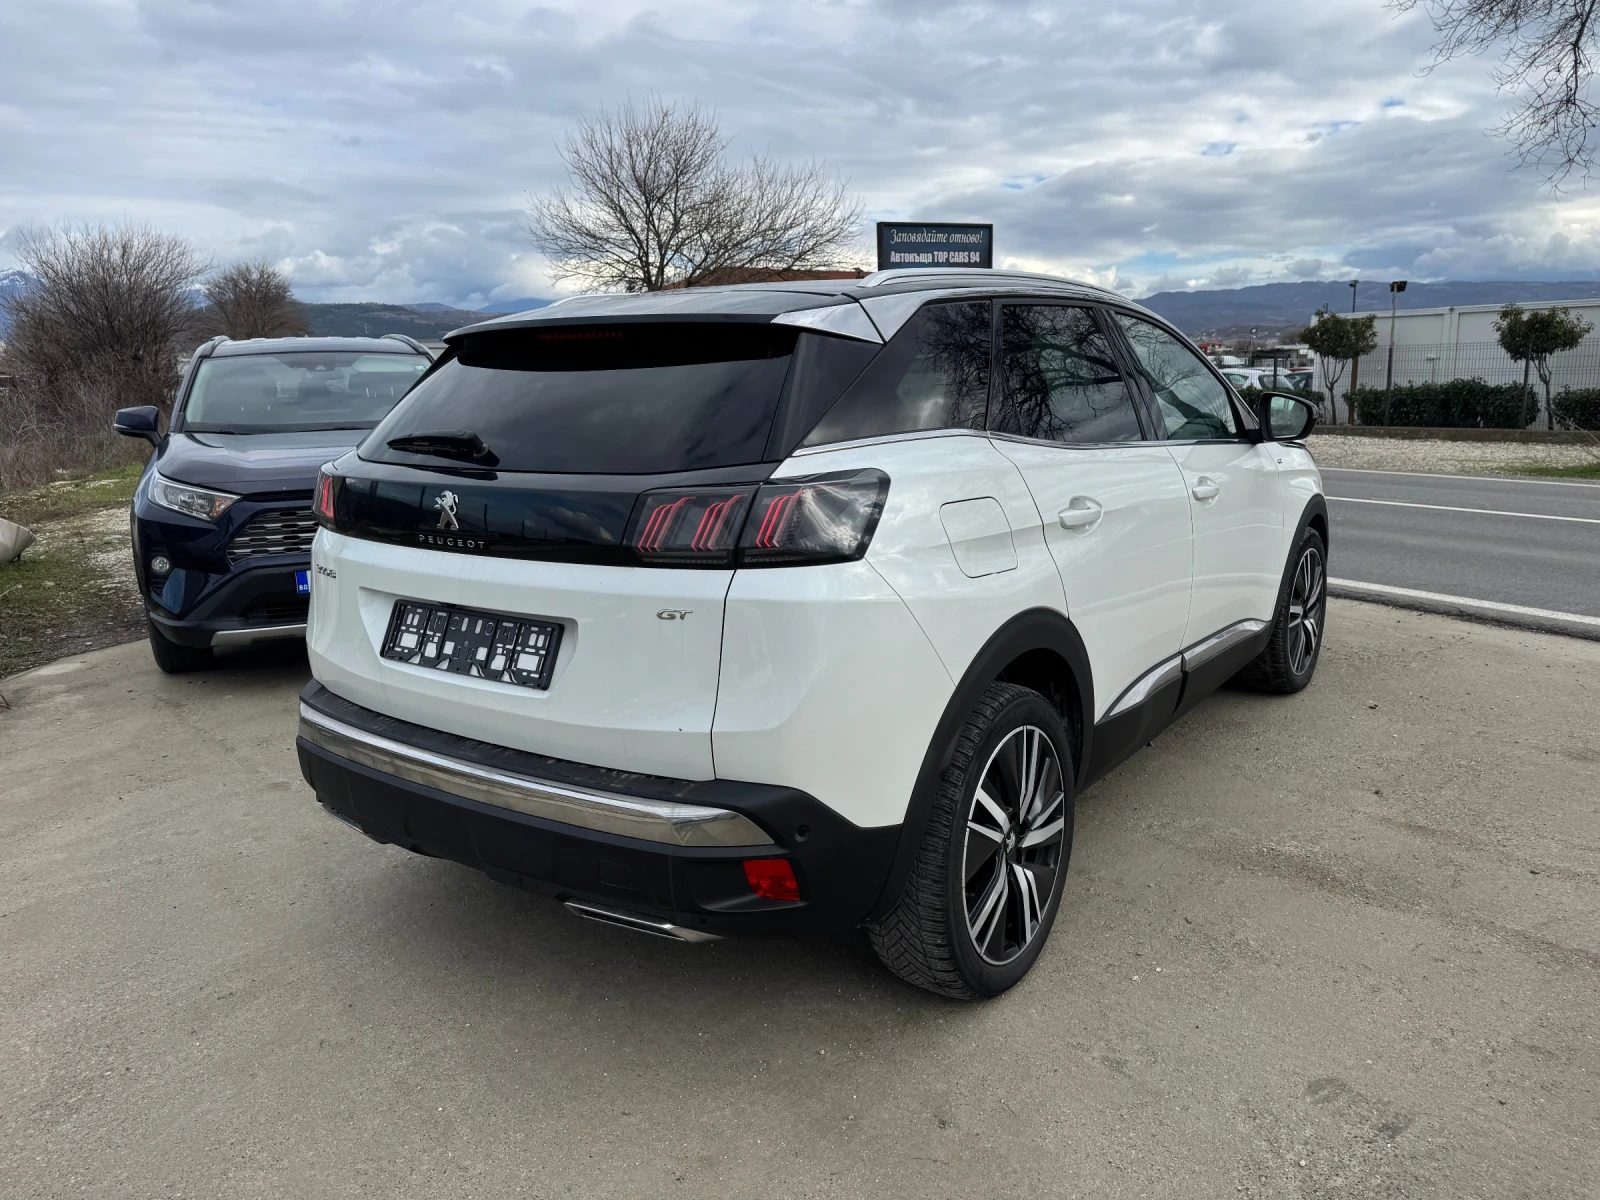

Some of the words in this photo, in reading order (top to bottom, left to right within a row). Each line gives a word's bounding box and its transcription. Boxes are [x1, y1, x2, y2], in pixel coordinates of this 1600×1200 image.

[890, 227, 948, 244] Заповядайте
[949, 230, 984, 244] отново!
[890, 251, 933, 264] Автокъща
[933, 251, 948, 263] TOP
[949, 251, 969, 263] CARS
[970, 251, 980, 263] 94
[418, 534, 485, 549] PEUGEOT
[656, 608, 694, 621] GT
